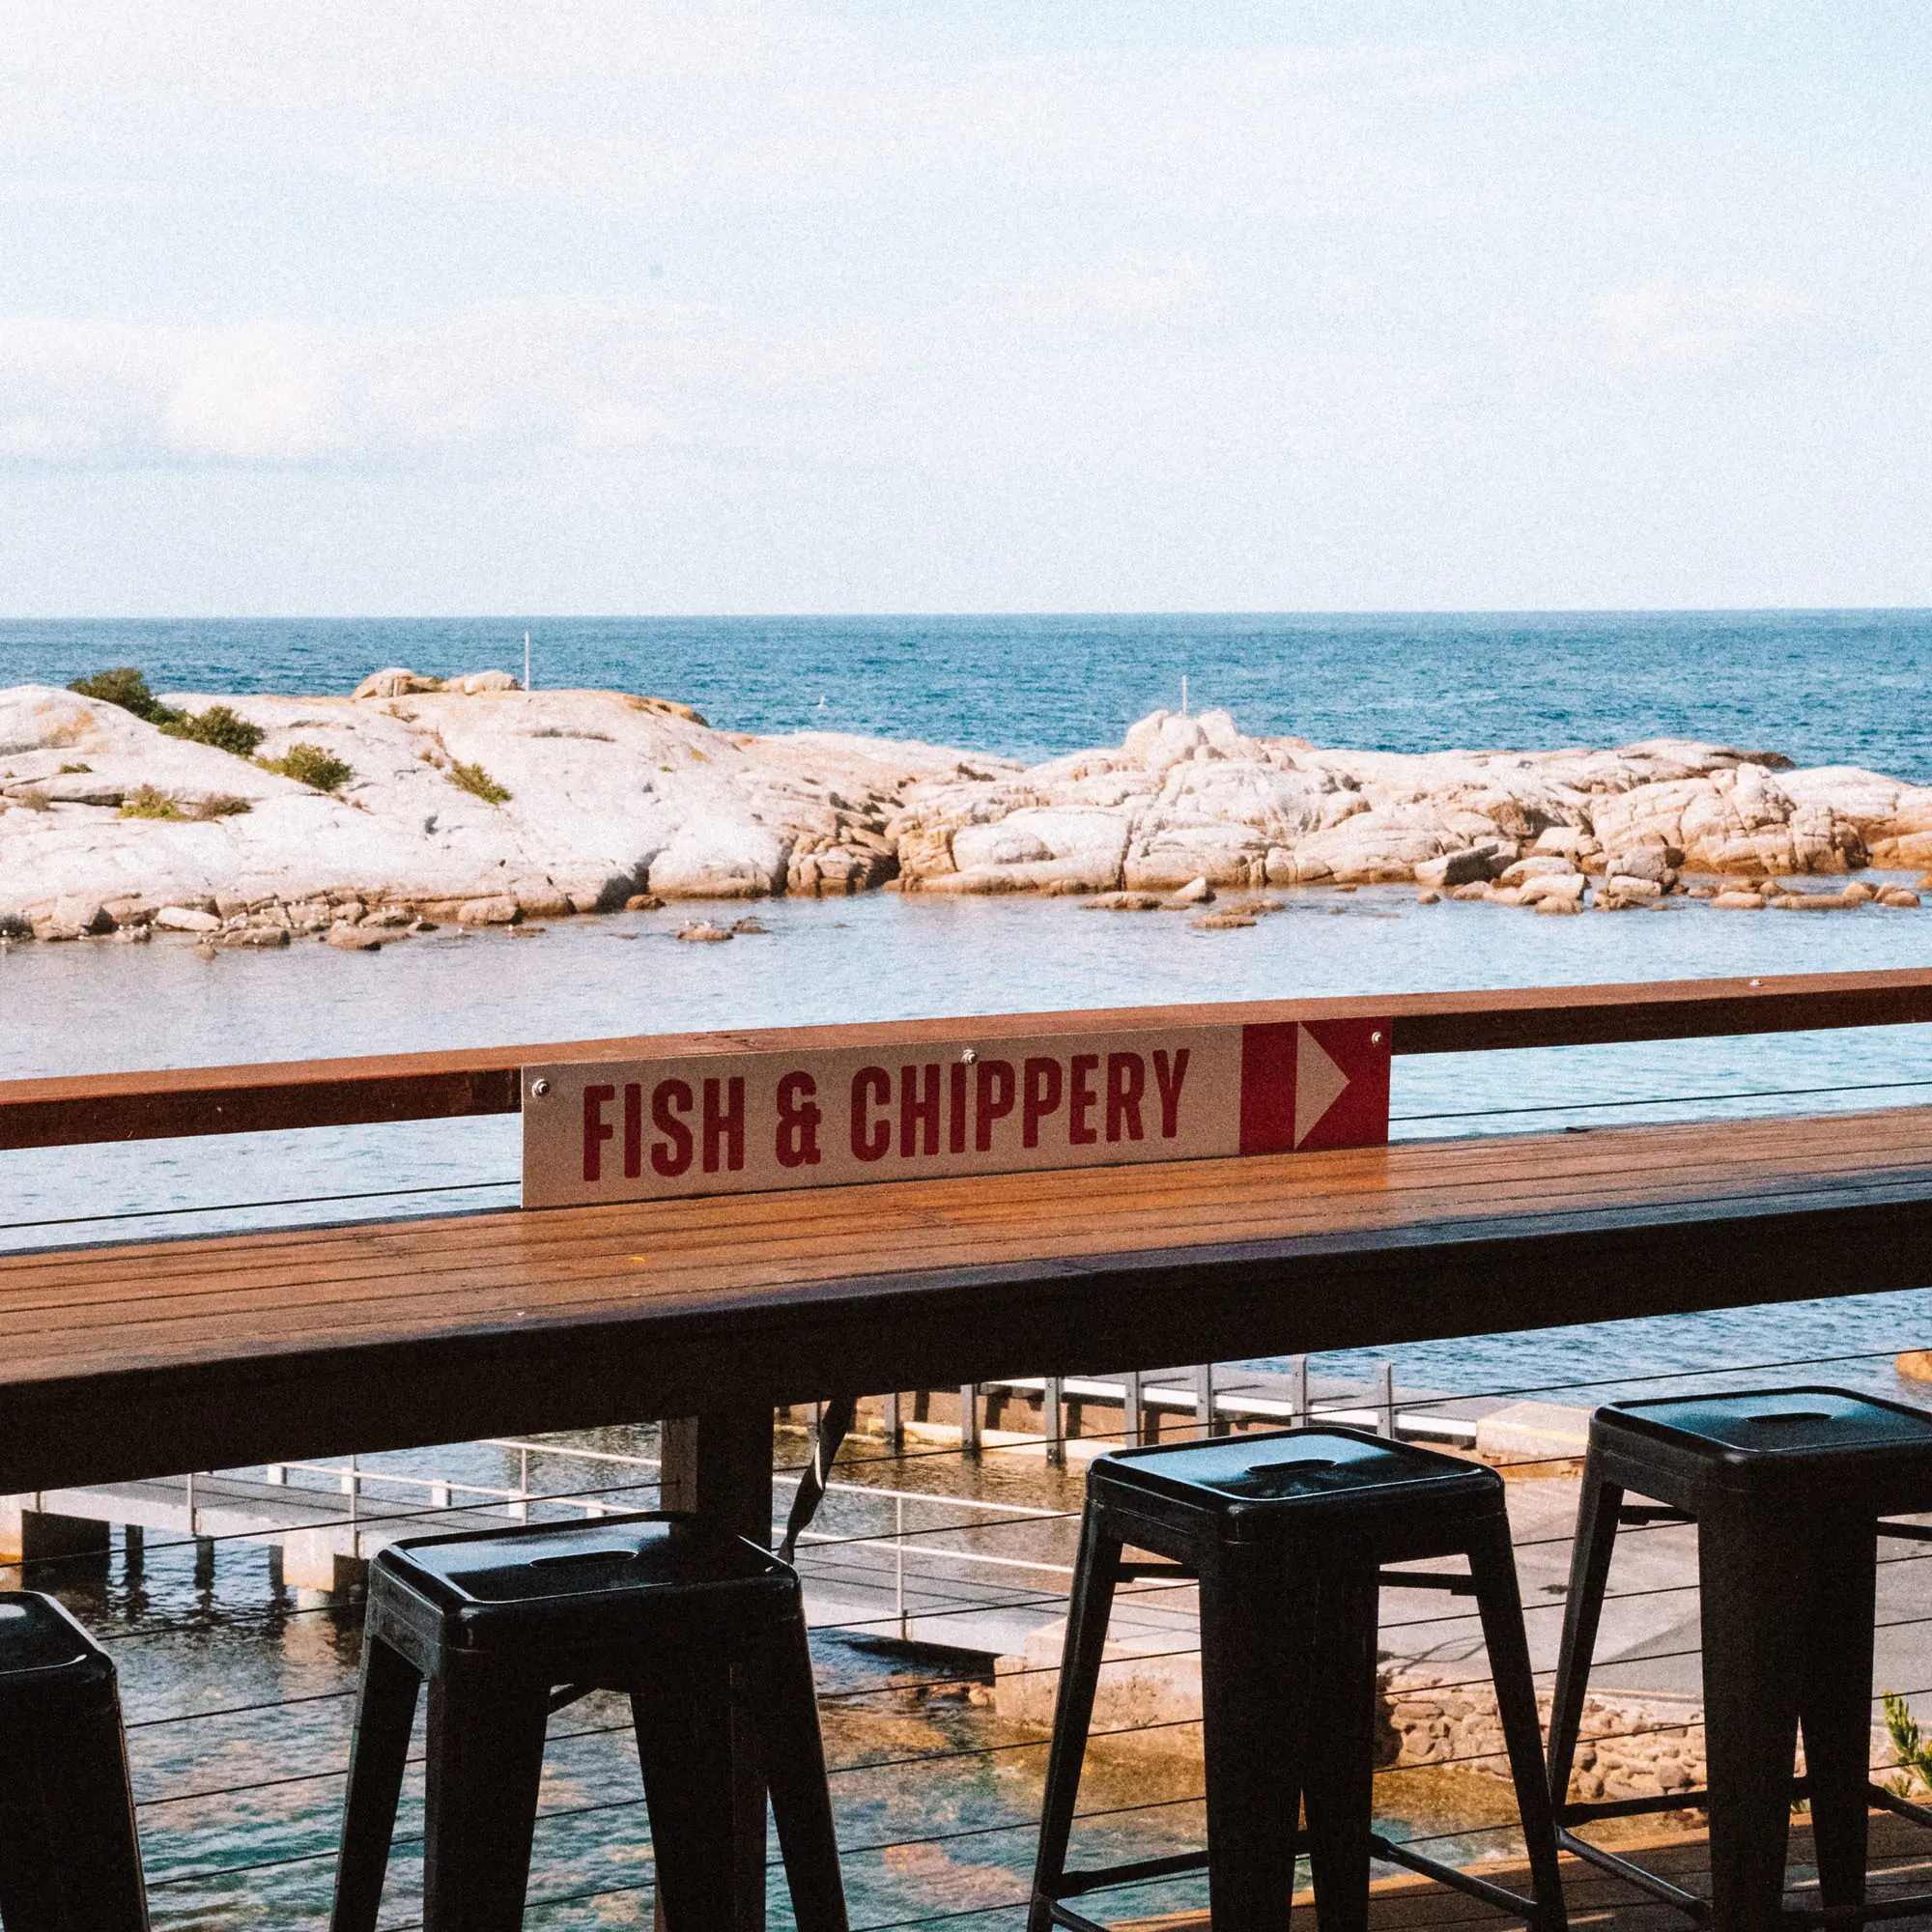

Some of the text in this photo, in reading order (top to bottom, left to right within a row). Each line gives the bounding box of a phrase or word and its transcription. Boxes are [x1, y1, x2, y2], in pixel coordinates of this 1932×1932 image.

[582, 1048, 1190, 1182] FISH & CHIPPERY
